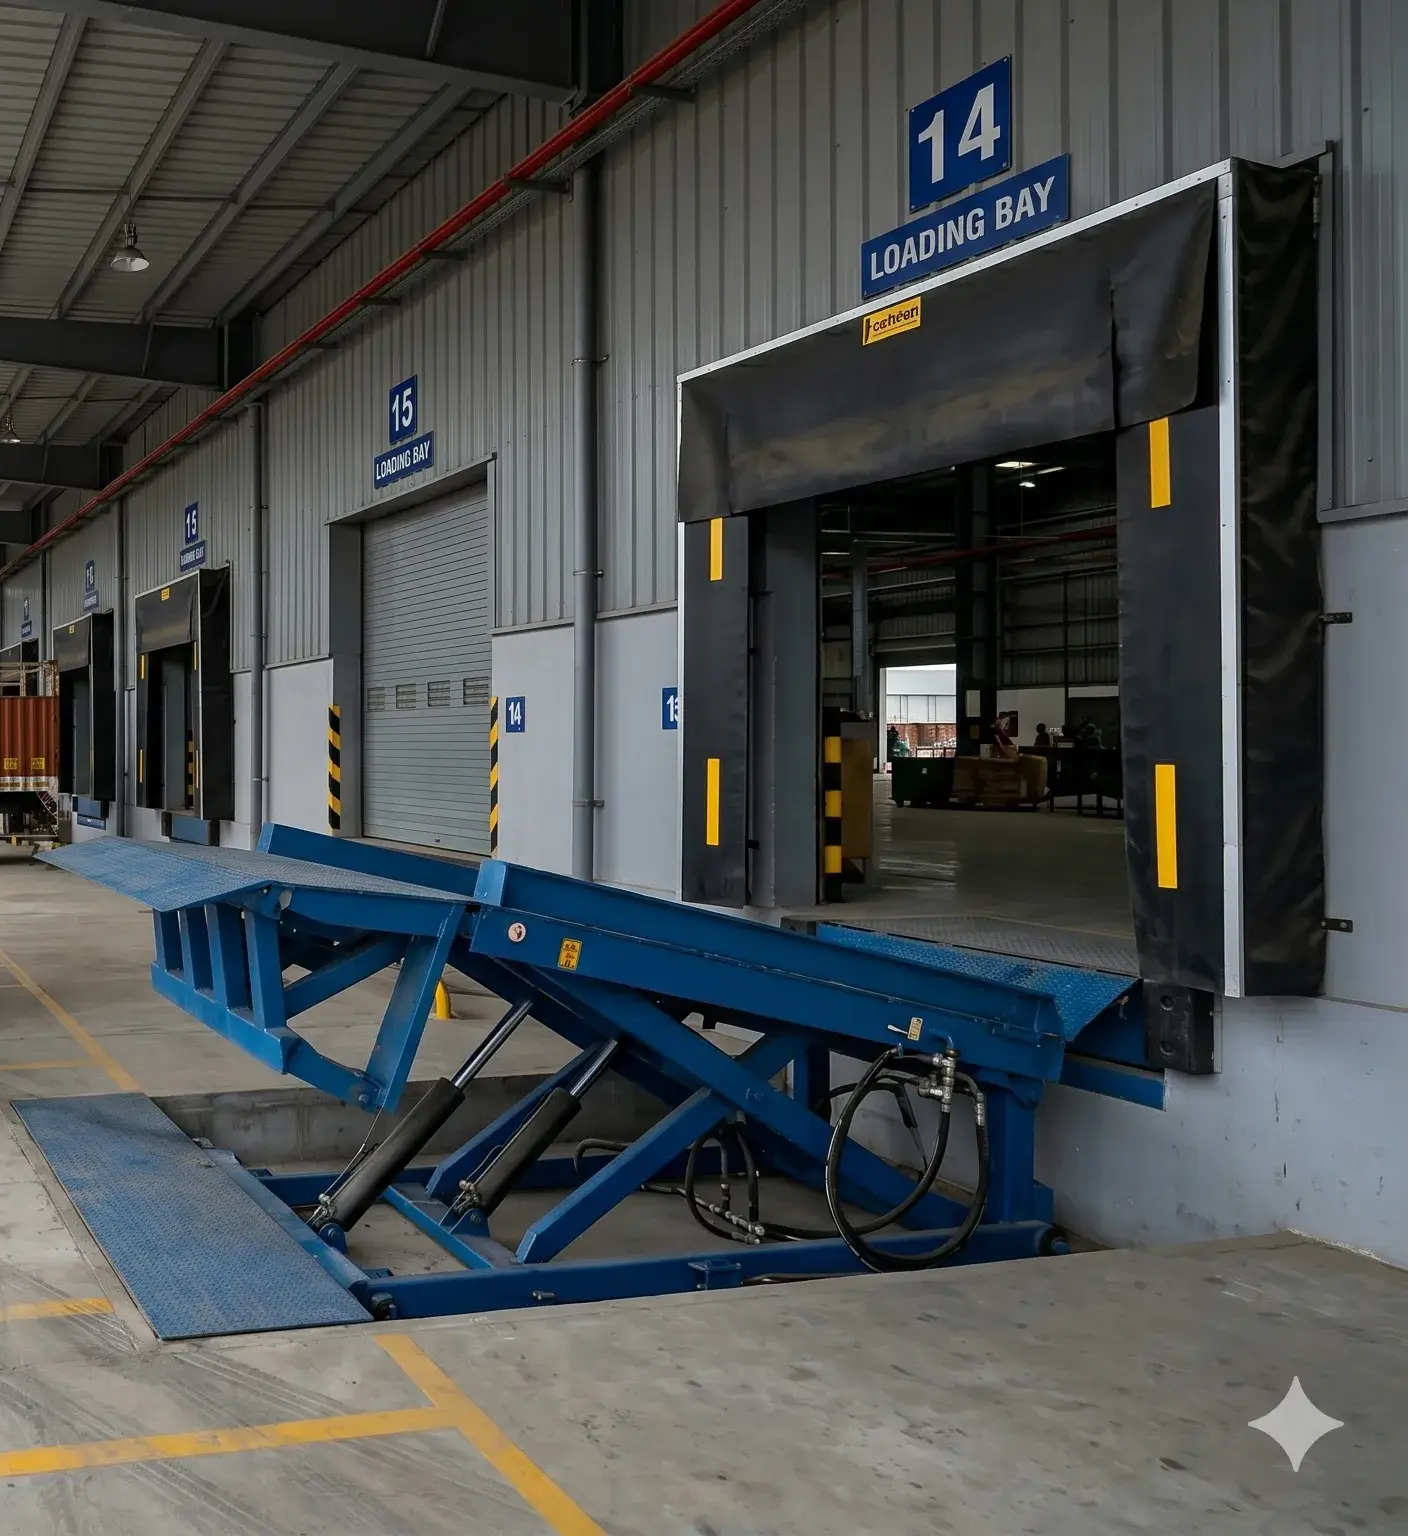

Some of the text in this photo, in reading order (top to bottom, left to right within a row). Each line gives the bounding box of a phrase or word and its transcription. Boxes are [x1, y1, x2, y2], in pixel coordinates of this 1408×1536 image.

[918, 83, 1001, 184] 14
[871, 175, 1056, 281] LOADING BAY
[392, 387, 413, 432] 15
[376, 440, 431, 480] LOADING BAY
[508, 701, 522, 725] 14
